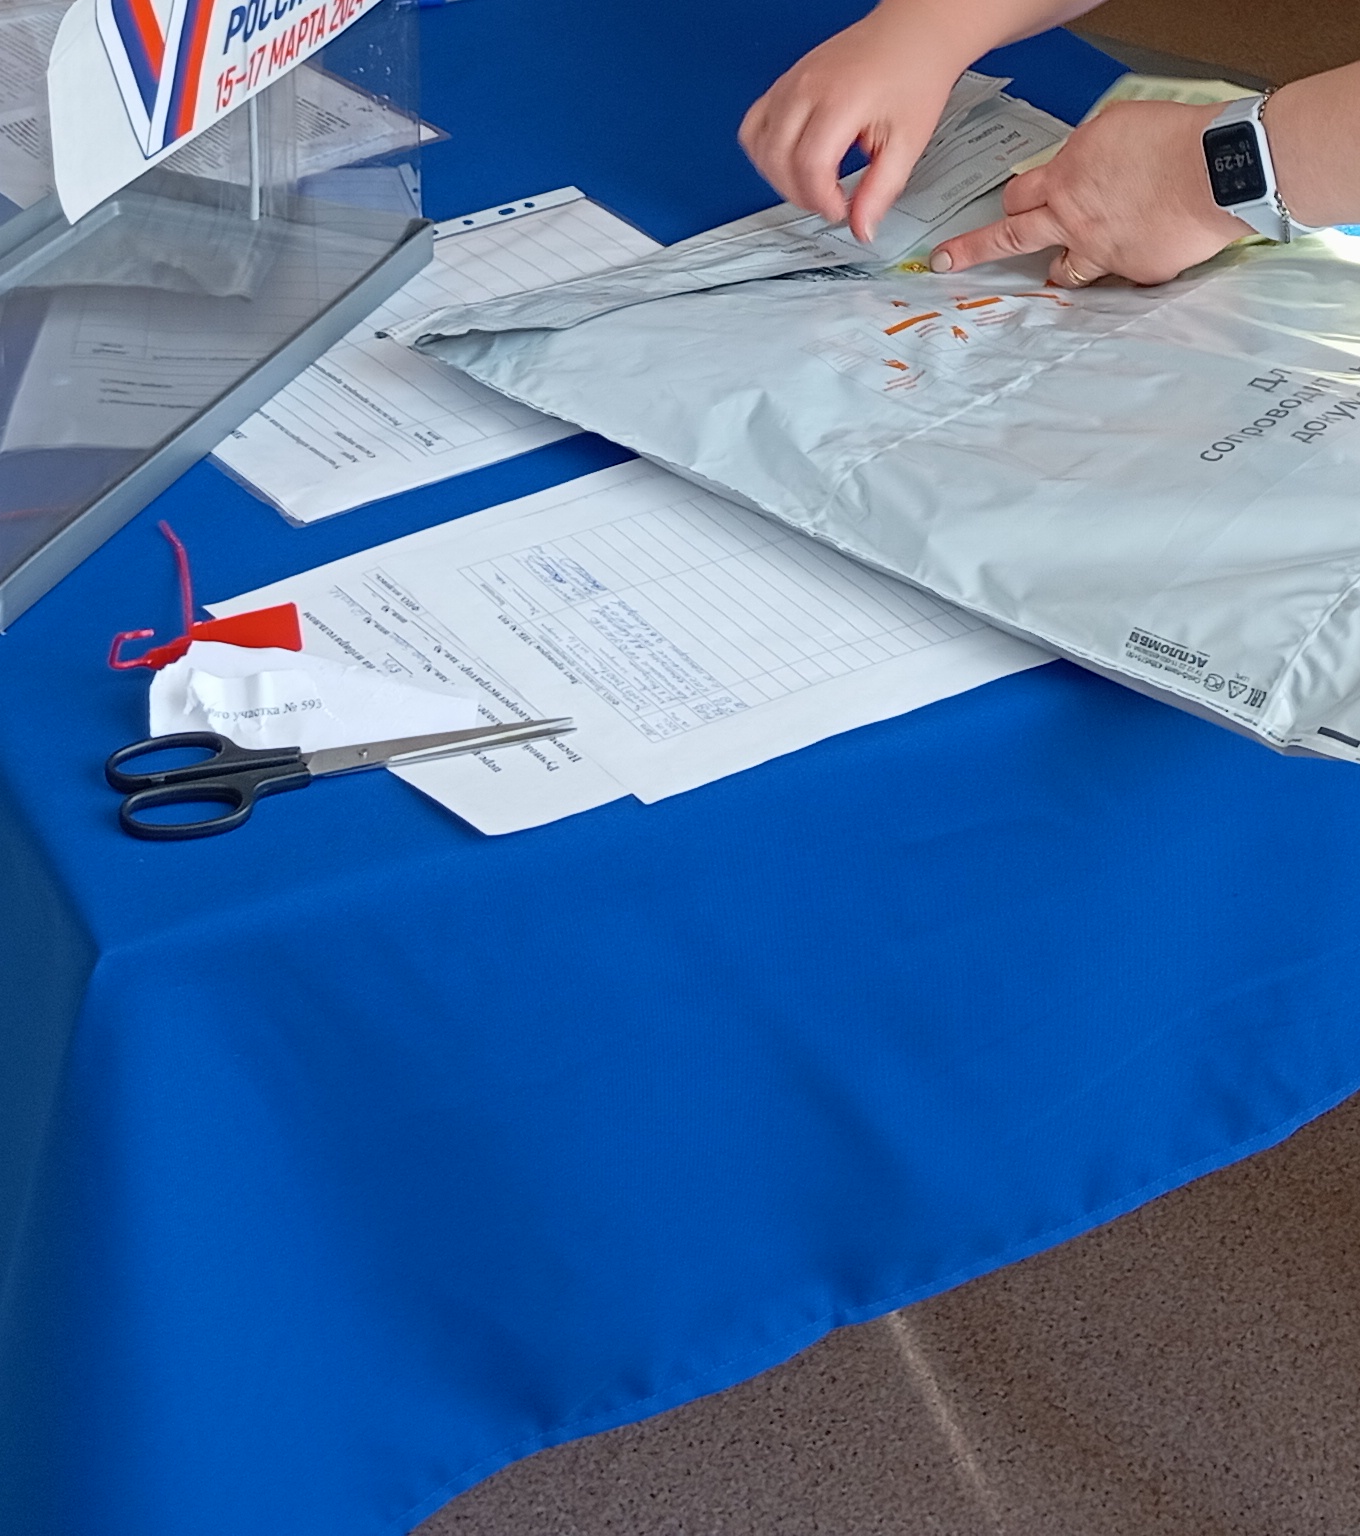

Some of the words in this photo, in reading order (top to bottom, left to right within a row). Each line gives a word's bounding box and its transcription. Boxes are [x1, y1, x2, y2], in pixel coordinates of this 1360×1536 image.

[269, 11, 327, 78] МАРТА
[1247, 365, 1292, 395] Дл
[233, 705, 280, 721] участка
[283, 701, 298, 716] №
[301, 698, 323, 711] 593
